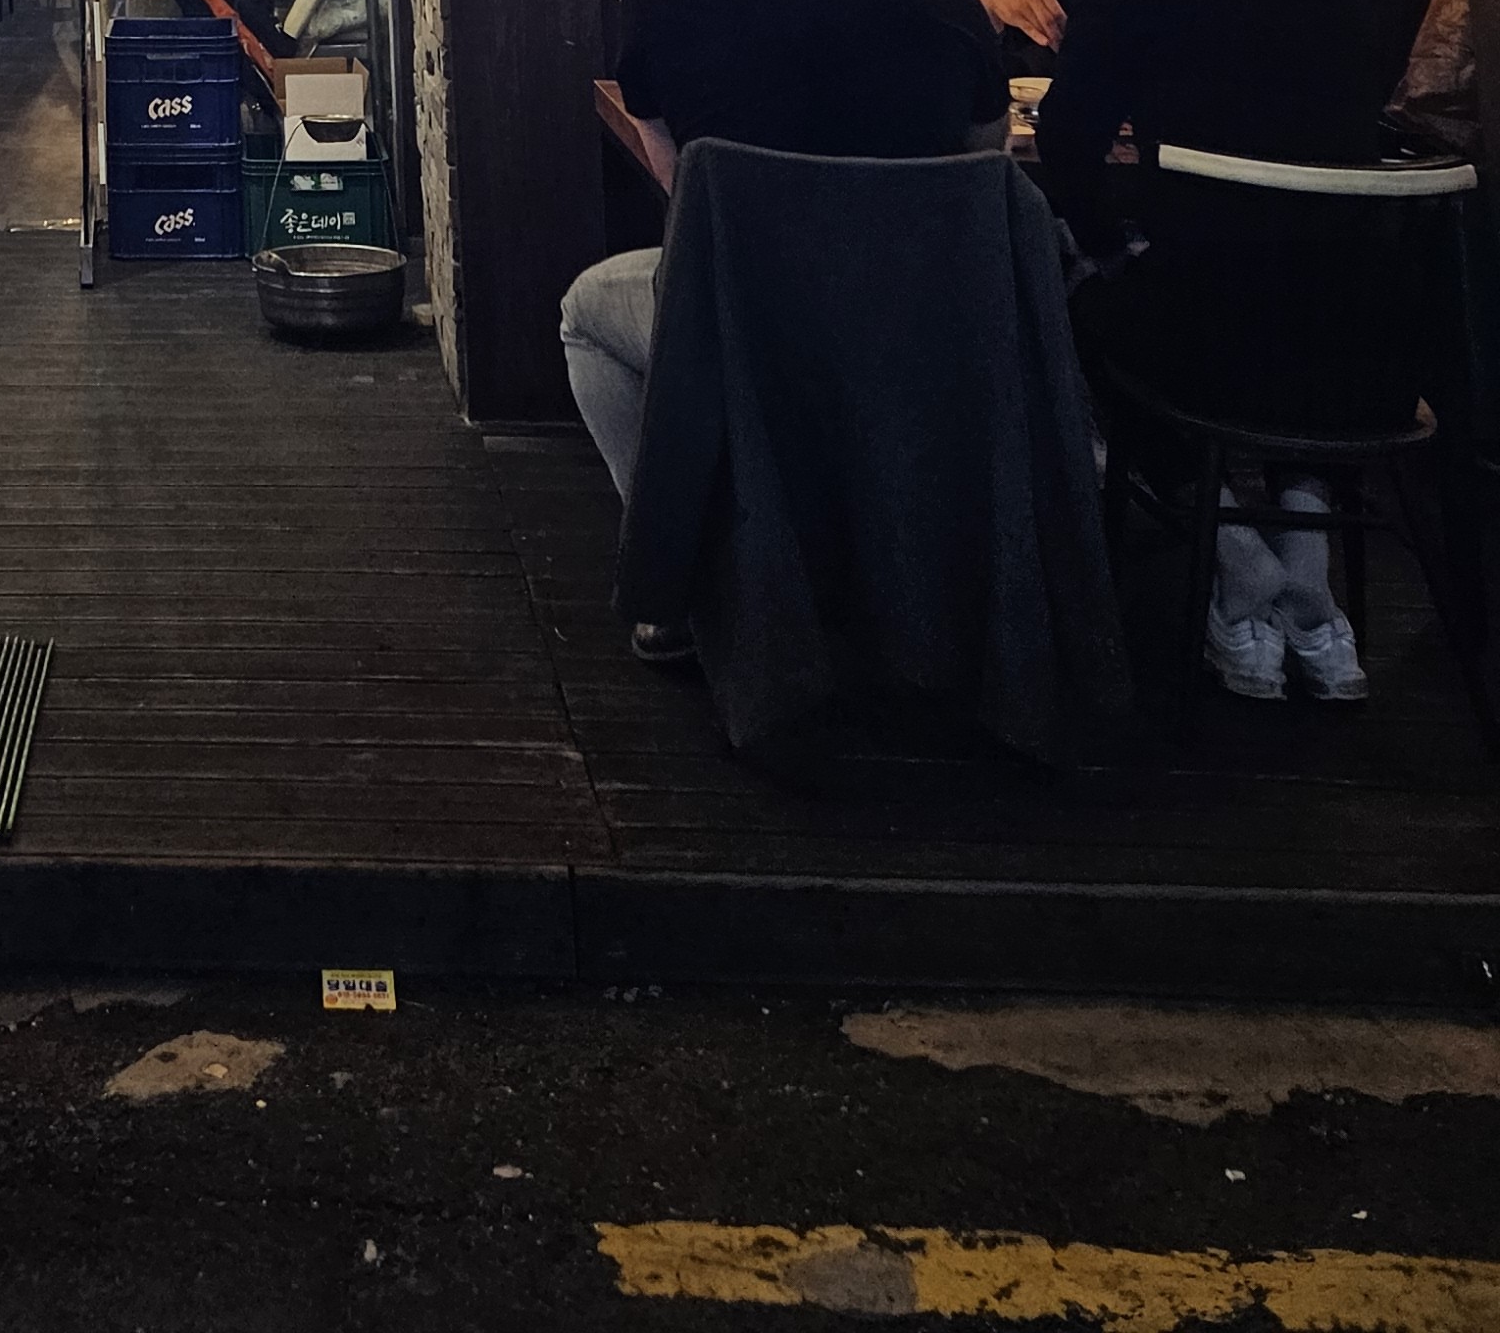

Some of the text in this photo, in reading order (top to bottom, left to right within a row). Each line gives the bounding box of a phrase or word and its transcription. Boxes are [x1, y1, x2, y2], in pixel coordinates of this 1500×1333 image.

[148, 94, 193, 121] Cass
[154, 207, 196, 235] Cass
[280, 208, 342, 233] 좋은데이
